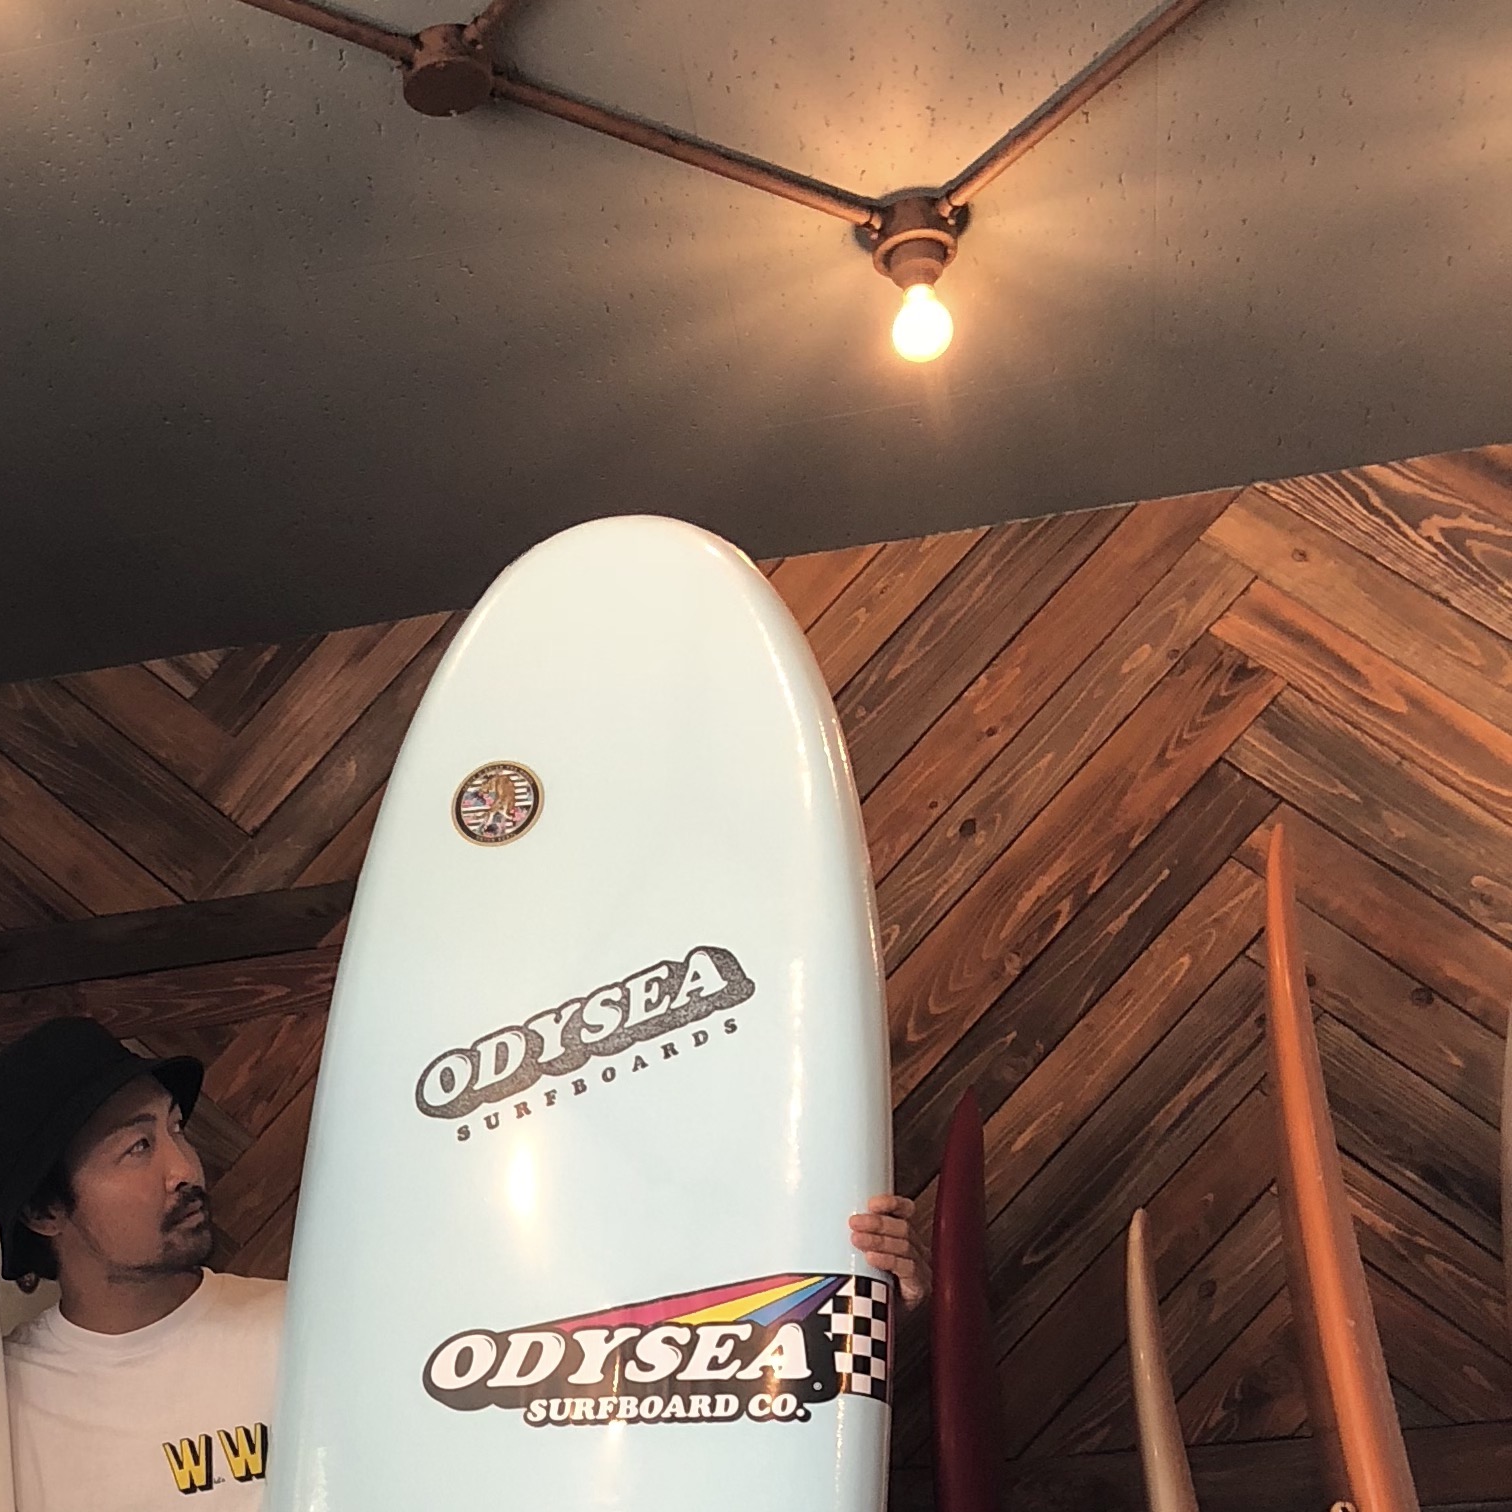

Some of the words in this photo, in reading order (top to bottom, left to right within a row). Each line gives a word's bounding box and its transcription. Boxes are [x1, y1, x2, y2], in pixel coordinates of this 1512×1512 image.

[420, 949, 731, 1108] ODYSEA
[456, 1017, 738, 1142] SURFBOARDS
[430, 1323, 812, 1391] ODYSEA
[525, 1393, 742, 1423] SURFBOARD
[746, 1392, 806, 1419] CO.
